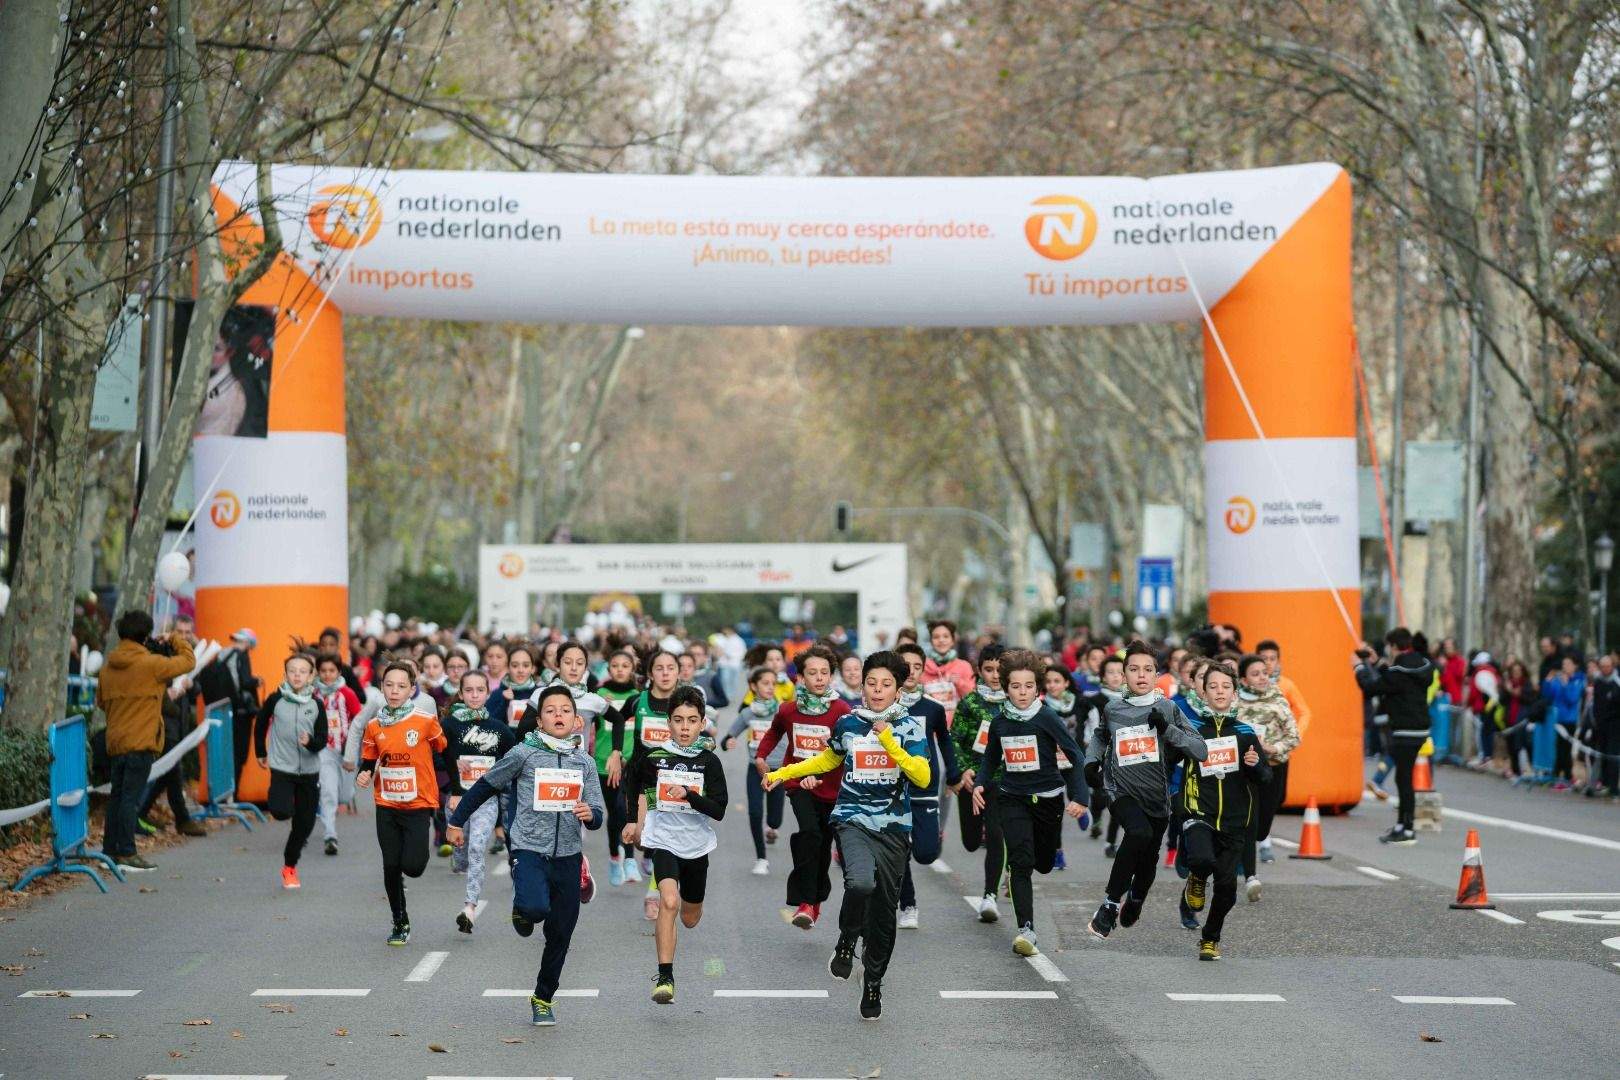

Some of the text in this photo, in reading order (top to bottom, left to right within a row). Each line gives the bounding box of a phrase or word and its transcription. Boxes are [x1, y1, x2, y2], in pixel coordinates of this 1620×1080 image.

[398, 194, 520, 214] nationale
[398, 216, 562, 242] nederlanden
[589, 215, 995, 241] La meta está muy cerca esperándote.
[1113, 219, 1277, 245] nederlanden
[781, 243, 801, 263] tú
[808, 245, 893, 268] puedes!
[350, 263, 474, 291] importas
[1025, 272, 1188, 299] Tú importas
[248, 493, 309, 504] nationale
[248, 507, 327, 519] nederlanden
[800, 738, 821, 749] 423
[1127, 740, 1146, 752] 714
[865, 754, 888, 766] 878
[1010, 750, 1027, 761] 701
[386, 781, 409, 791] 1460
[549, 786, 570, 798] 761
